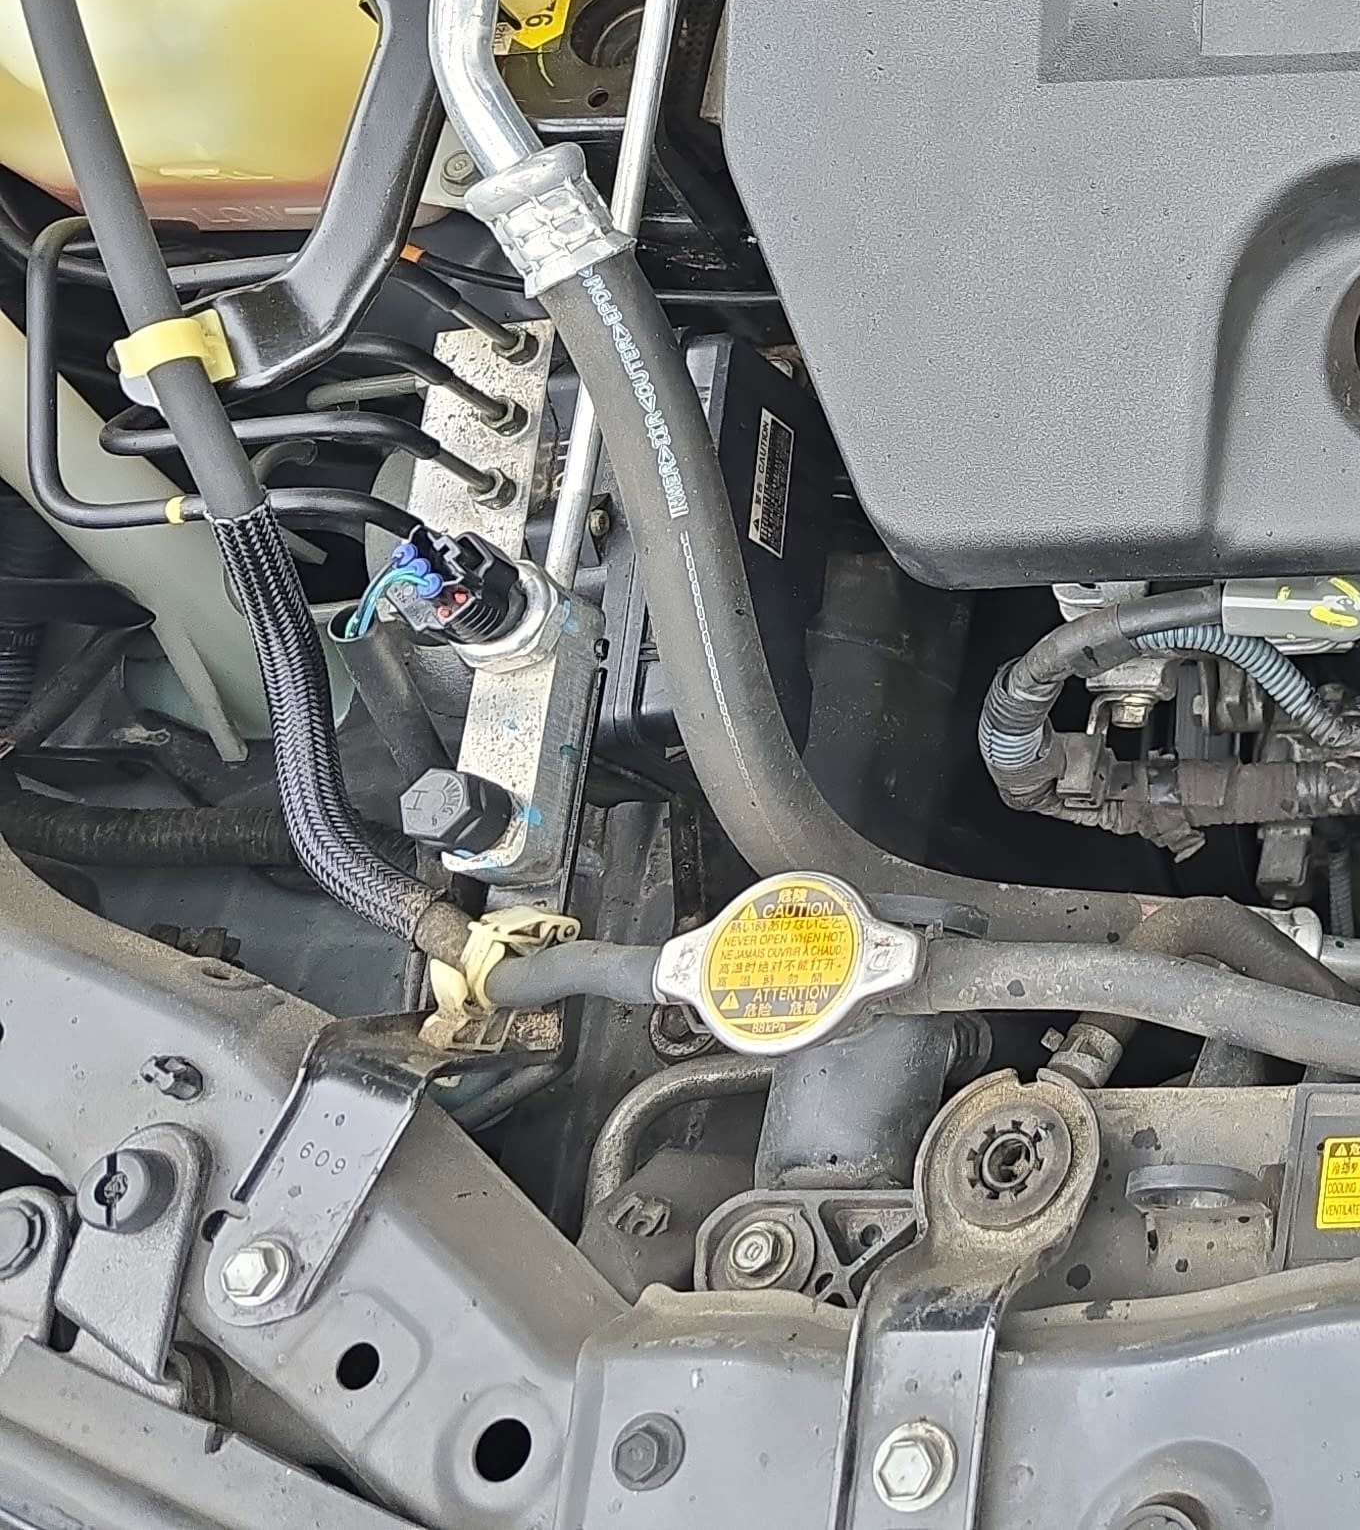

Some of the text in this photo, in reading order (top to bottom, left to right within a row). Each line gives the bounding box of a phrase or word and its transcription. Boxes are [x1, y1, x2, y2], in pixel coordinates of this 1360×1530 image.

[191, 206, 283, 224] LOW
[758, 421, 769, 473] CAUTION
[777, 888, 809, 903] 危険
[762, 901, 835, 919] CAUTION
[723, 931, 847, 948] NEVER OPEN WHEN HOT.
[721, 950, 731, 960] NE
[734, 949, 765, 960] JAMAIS
[767, 947, 800, 958] OUVRIR
[753, 985, 830, 1003] ATTENTION
[752, 1022, 786, 1033] 88kPa
[299, 1140, 346, 1175] 609
[1328, 1182, 1357, 1194] COOLING
